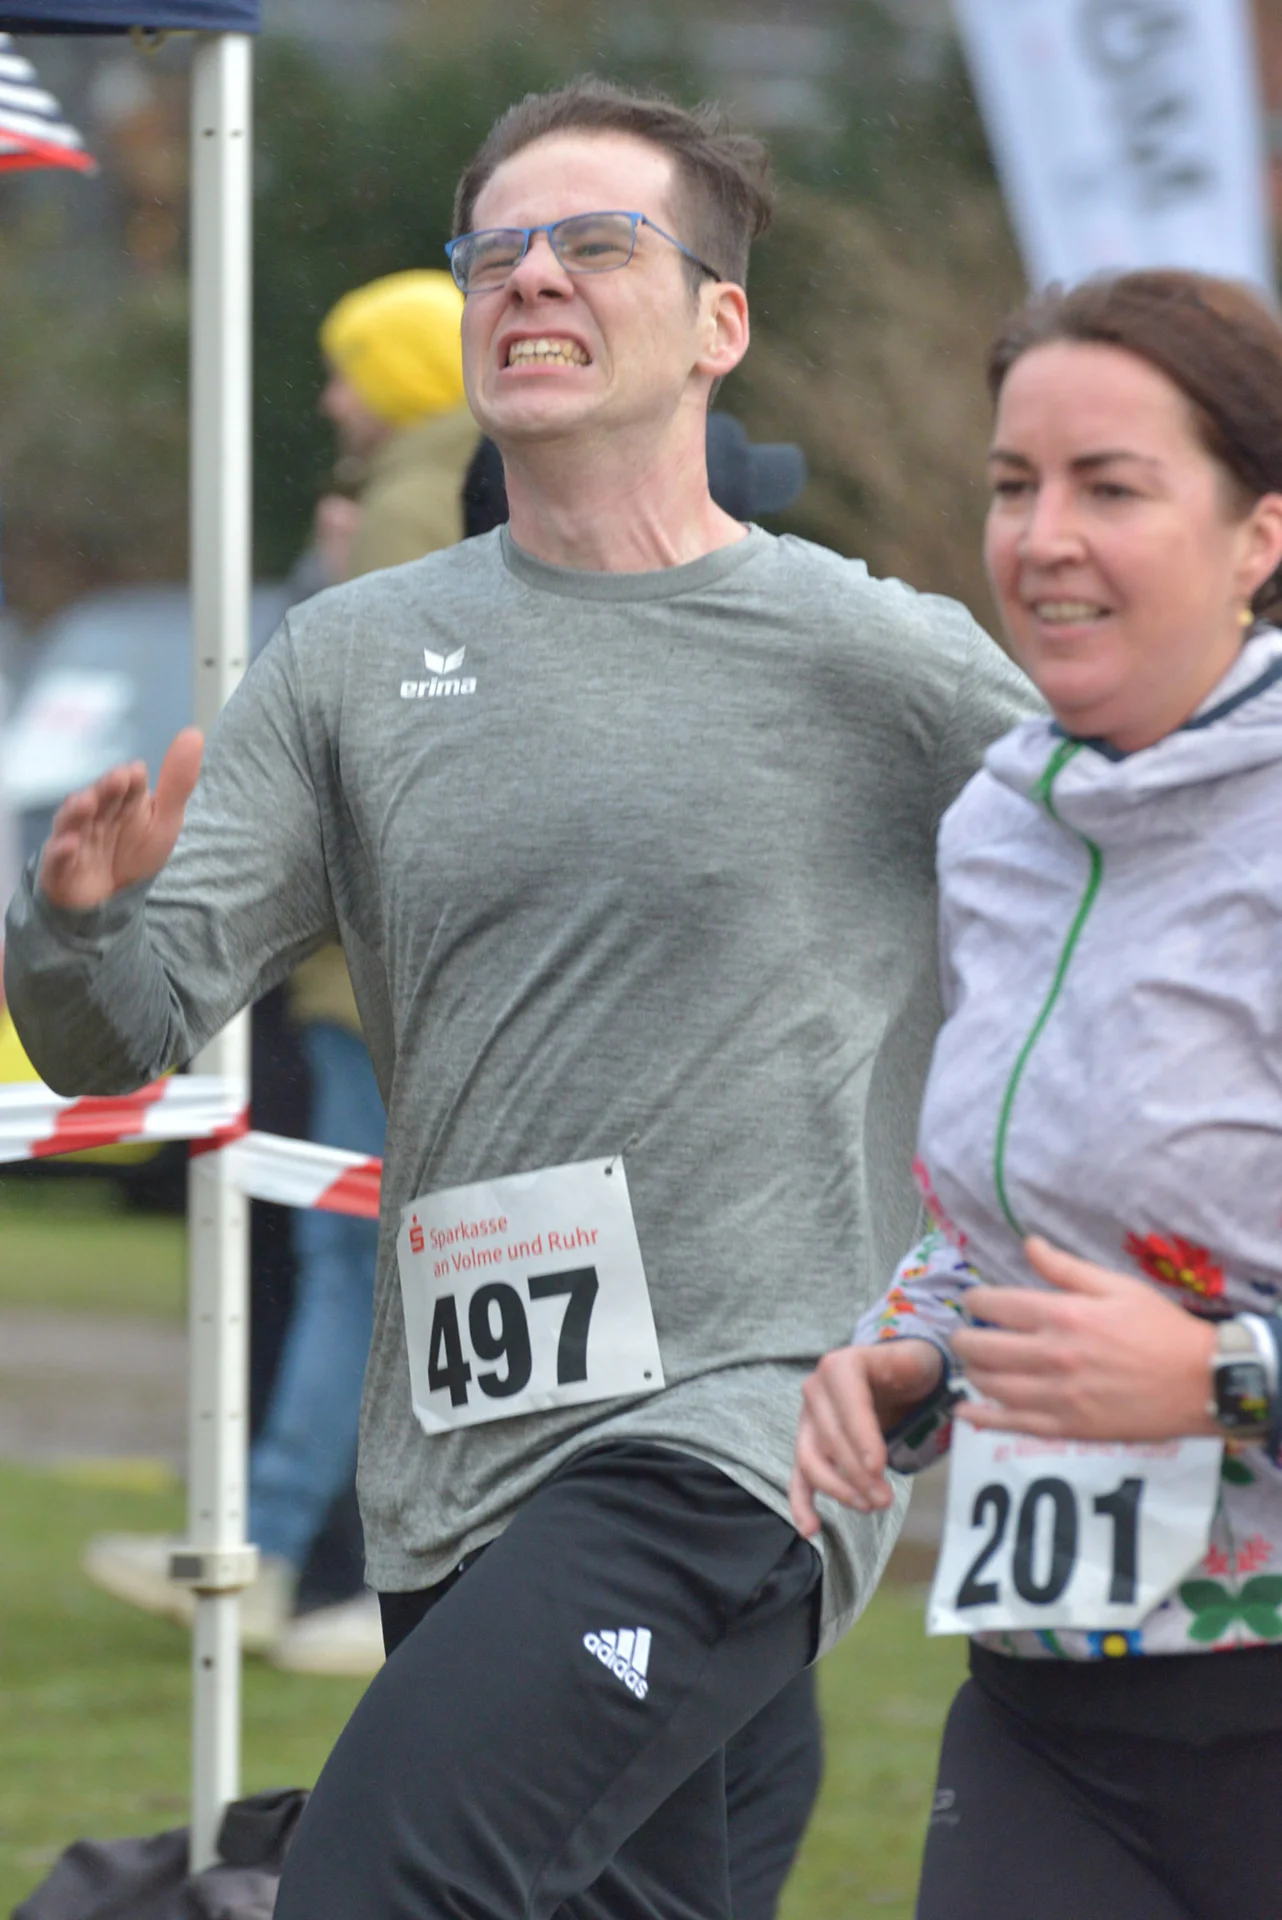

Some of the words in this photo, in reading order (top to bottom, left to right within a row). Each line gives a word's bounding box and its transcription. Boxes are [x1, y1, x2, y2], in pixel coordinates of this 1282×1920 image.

[400, 676, 477, 699] erima
[429, 1215, 508, 1250] Sparkasse
[433, 1260, 450, 1278] an
[451, 1246, 503, 1272] Volme
[507, 1234, 543, 1261] und
[548, 1226, 600, 1251] Ruhr
[427, 1265, 600, 1410] 497
[955, 1474, 1146, 1609] 201
[583, 1631, 649, 1700] adidas
